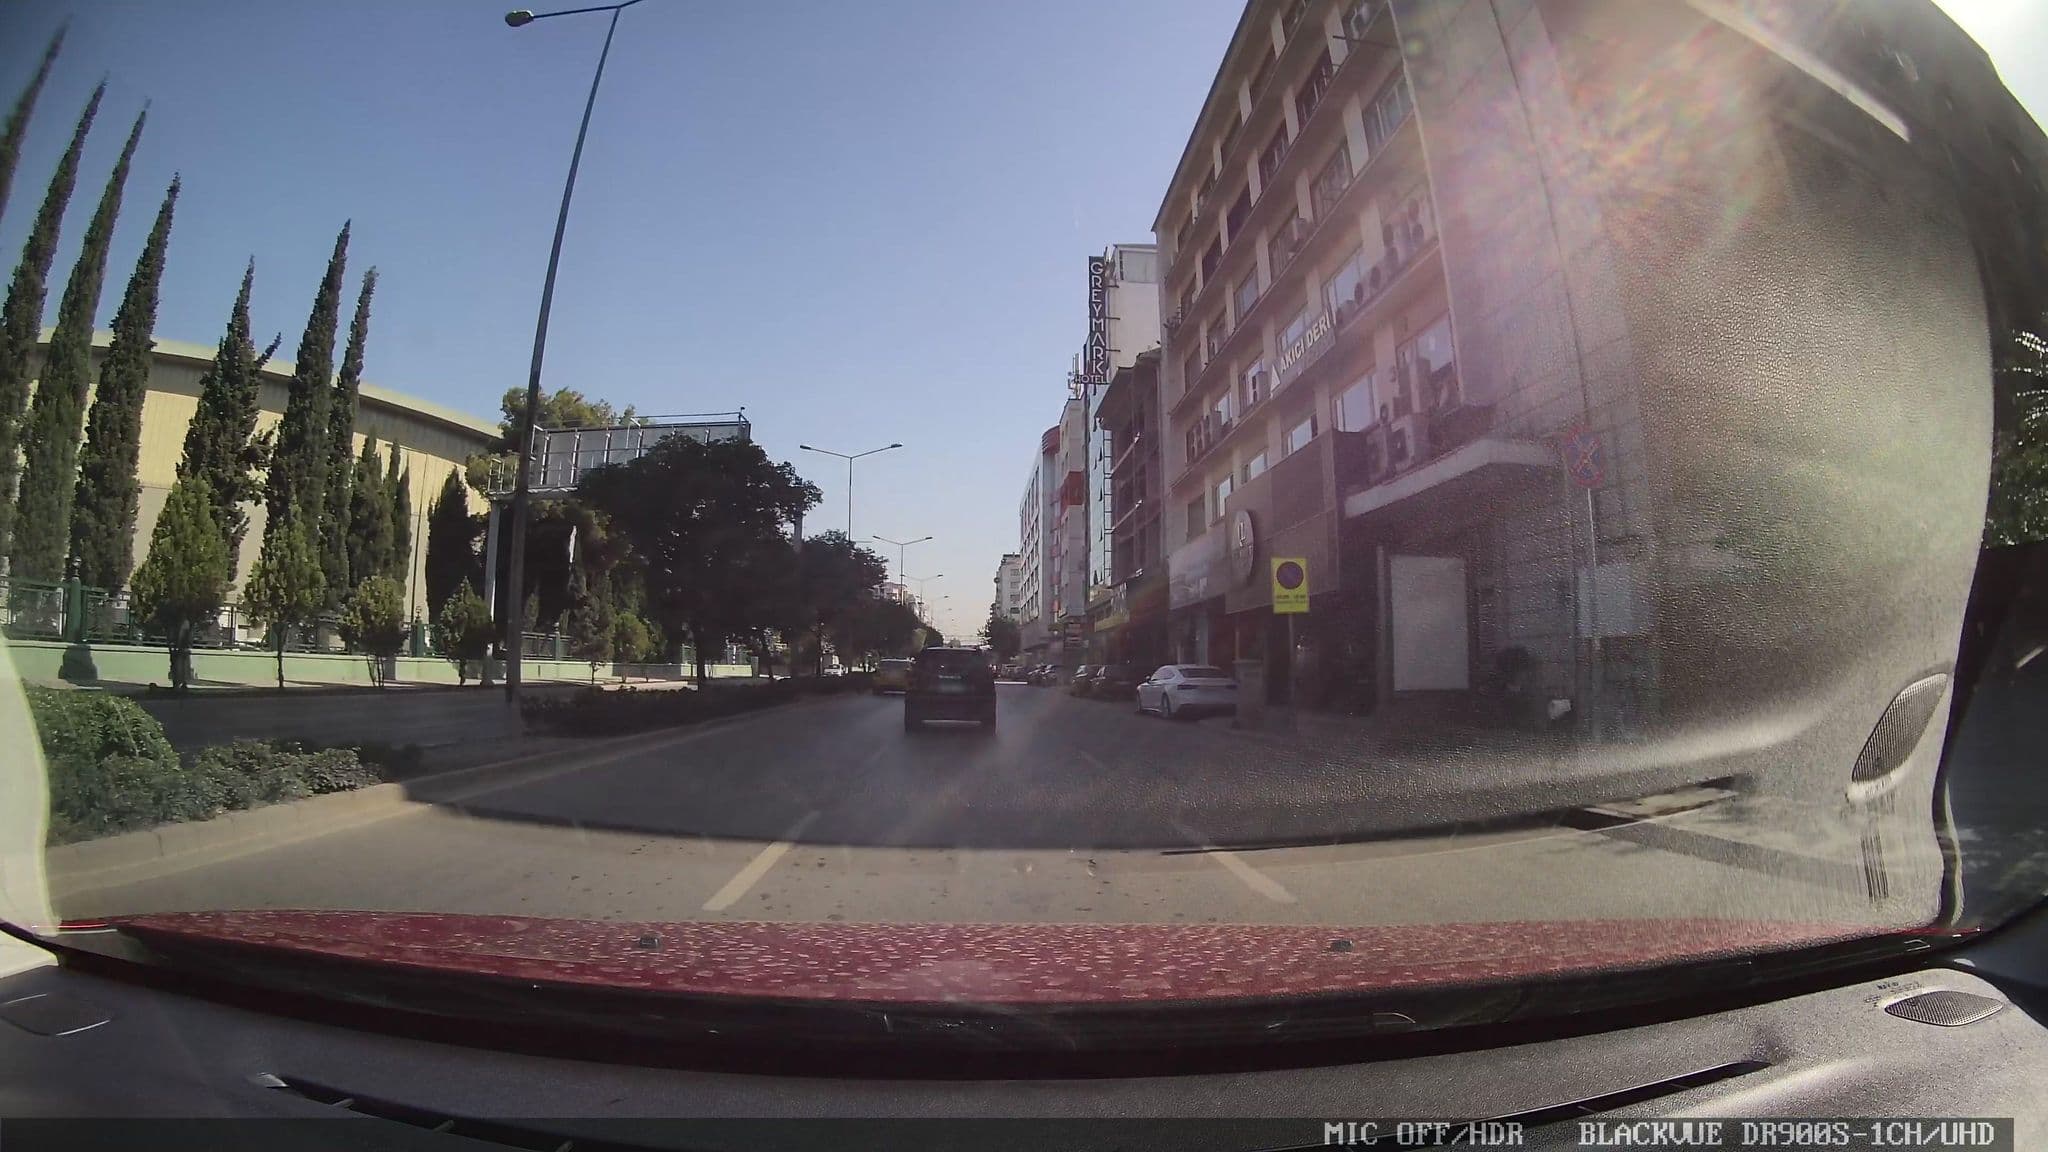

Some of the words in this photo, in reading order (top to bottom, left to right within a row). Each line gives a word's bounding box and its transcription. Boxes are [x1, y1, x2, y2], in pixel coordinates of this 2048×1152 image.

[1090, 261, 1106, 375] GREYMARK
[1280, 337, 1306, 374] AKICI
[1074, 374, 1106, 384] HOTEL
